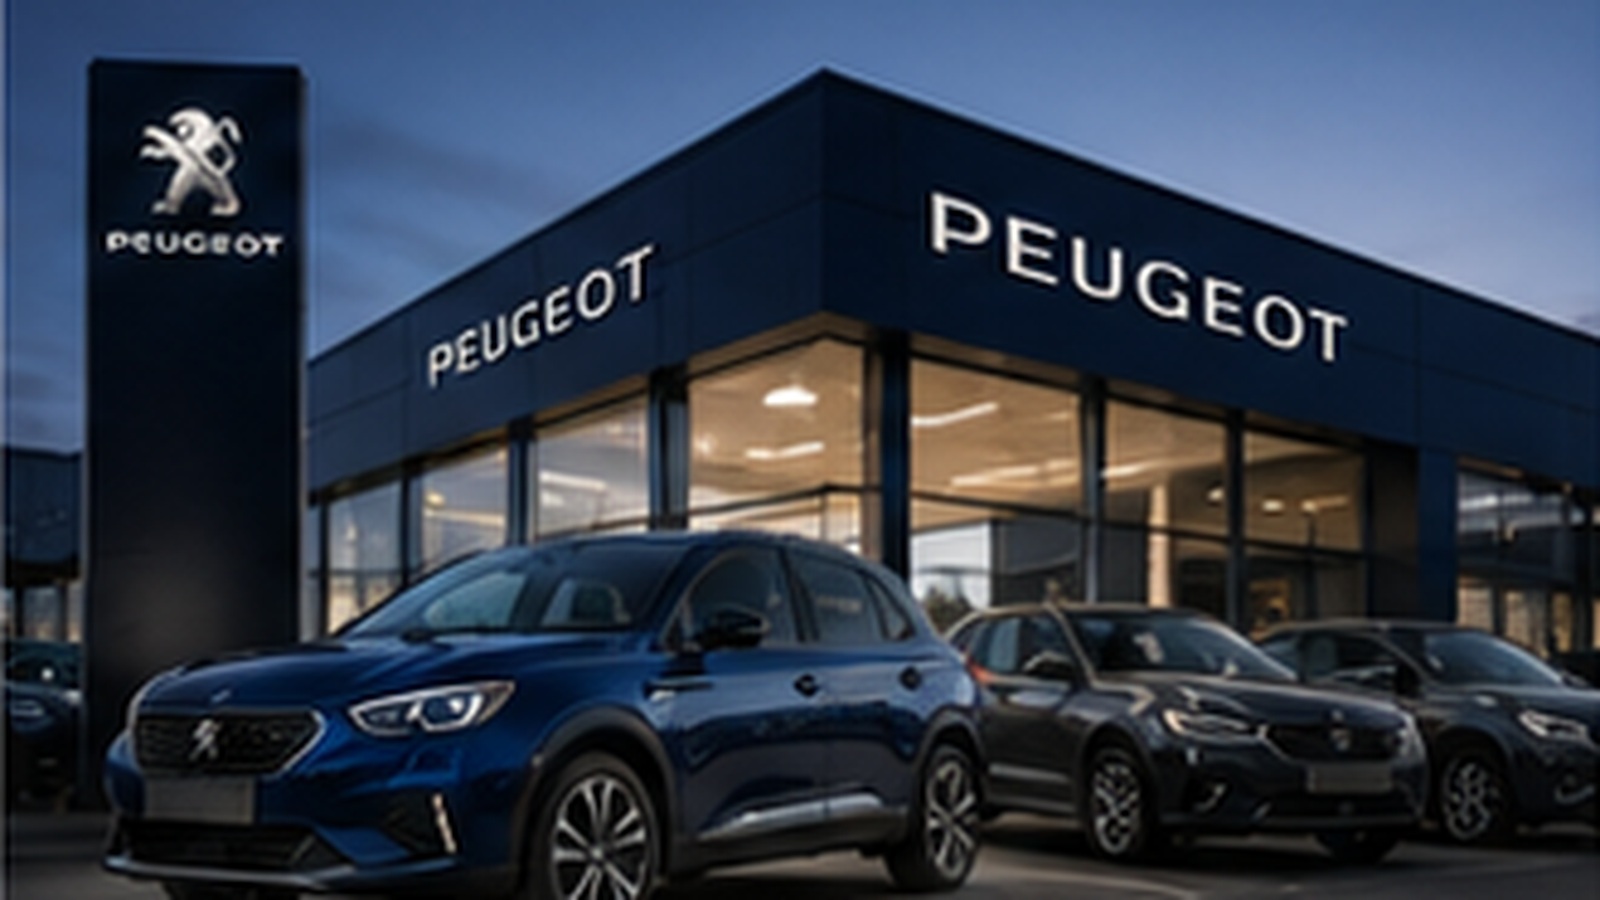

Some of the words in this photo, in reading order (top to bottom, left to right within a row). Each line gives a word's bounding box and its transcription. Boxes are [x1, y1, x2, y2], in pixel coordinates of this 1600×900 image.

[106, 231, 283, 256] PEUGEOT
[931, 192, 1348, 362] PEUGEOT
[428, 245, 653, 387] PEUGEOT
